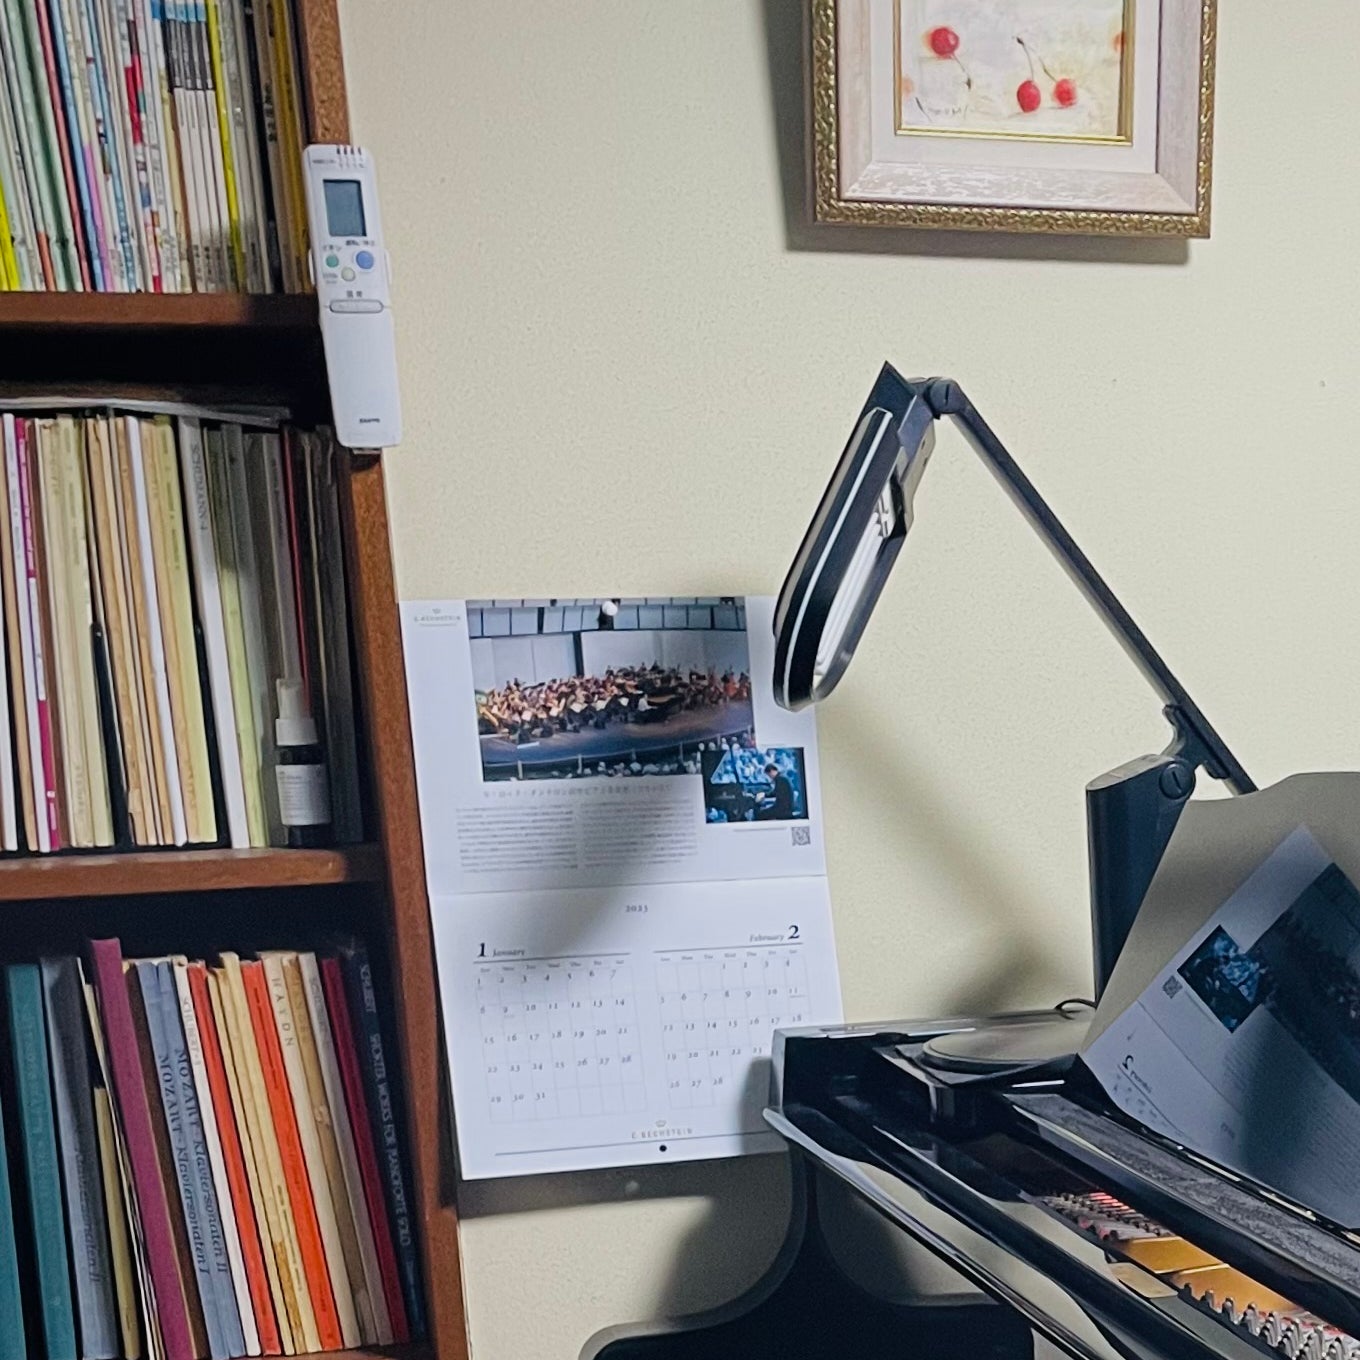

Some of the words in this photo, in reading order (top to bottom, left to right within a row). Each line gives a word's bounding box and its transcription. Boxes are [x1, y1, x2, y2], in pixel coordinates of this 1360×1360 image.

[477, 942, 487, 957] 1
[749, 933, 785, 943] February
[787, 925, 801, 940] 2
[272, 977, 294, 1047] HAYDN
[158, 1052, 183, 1134] MOZART
[176, 1049, 199, 1126] MOZART
